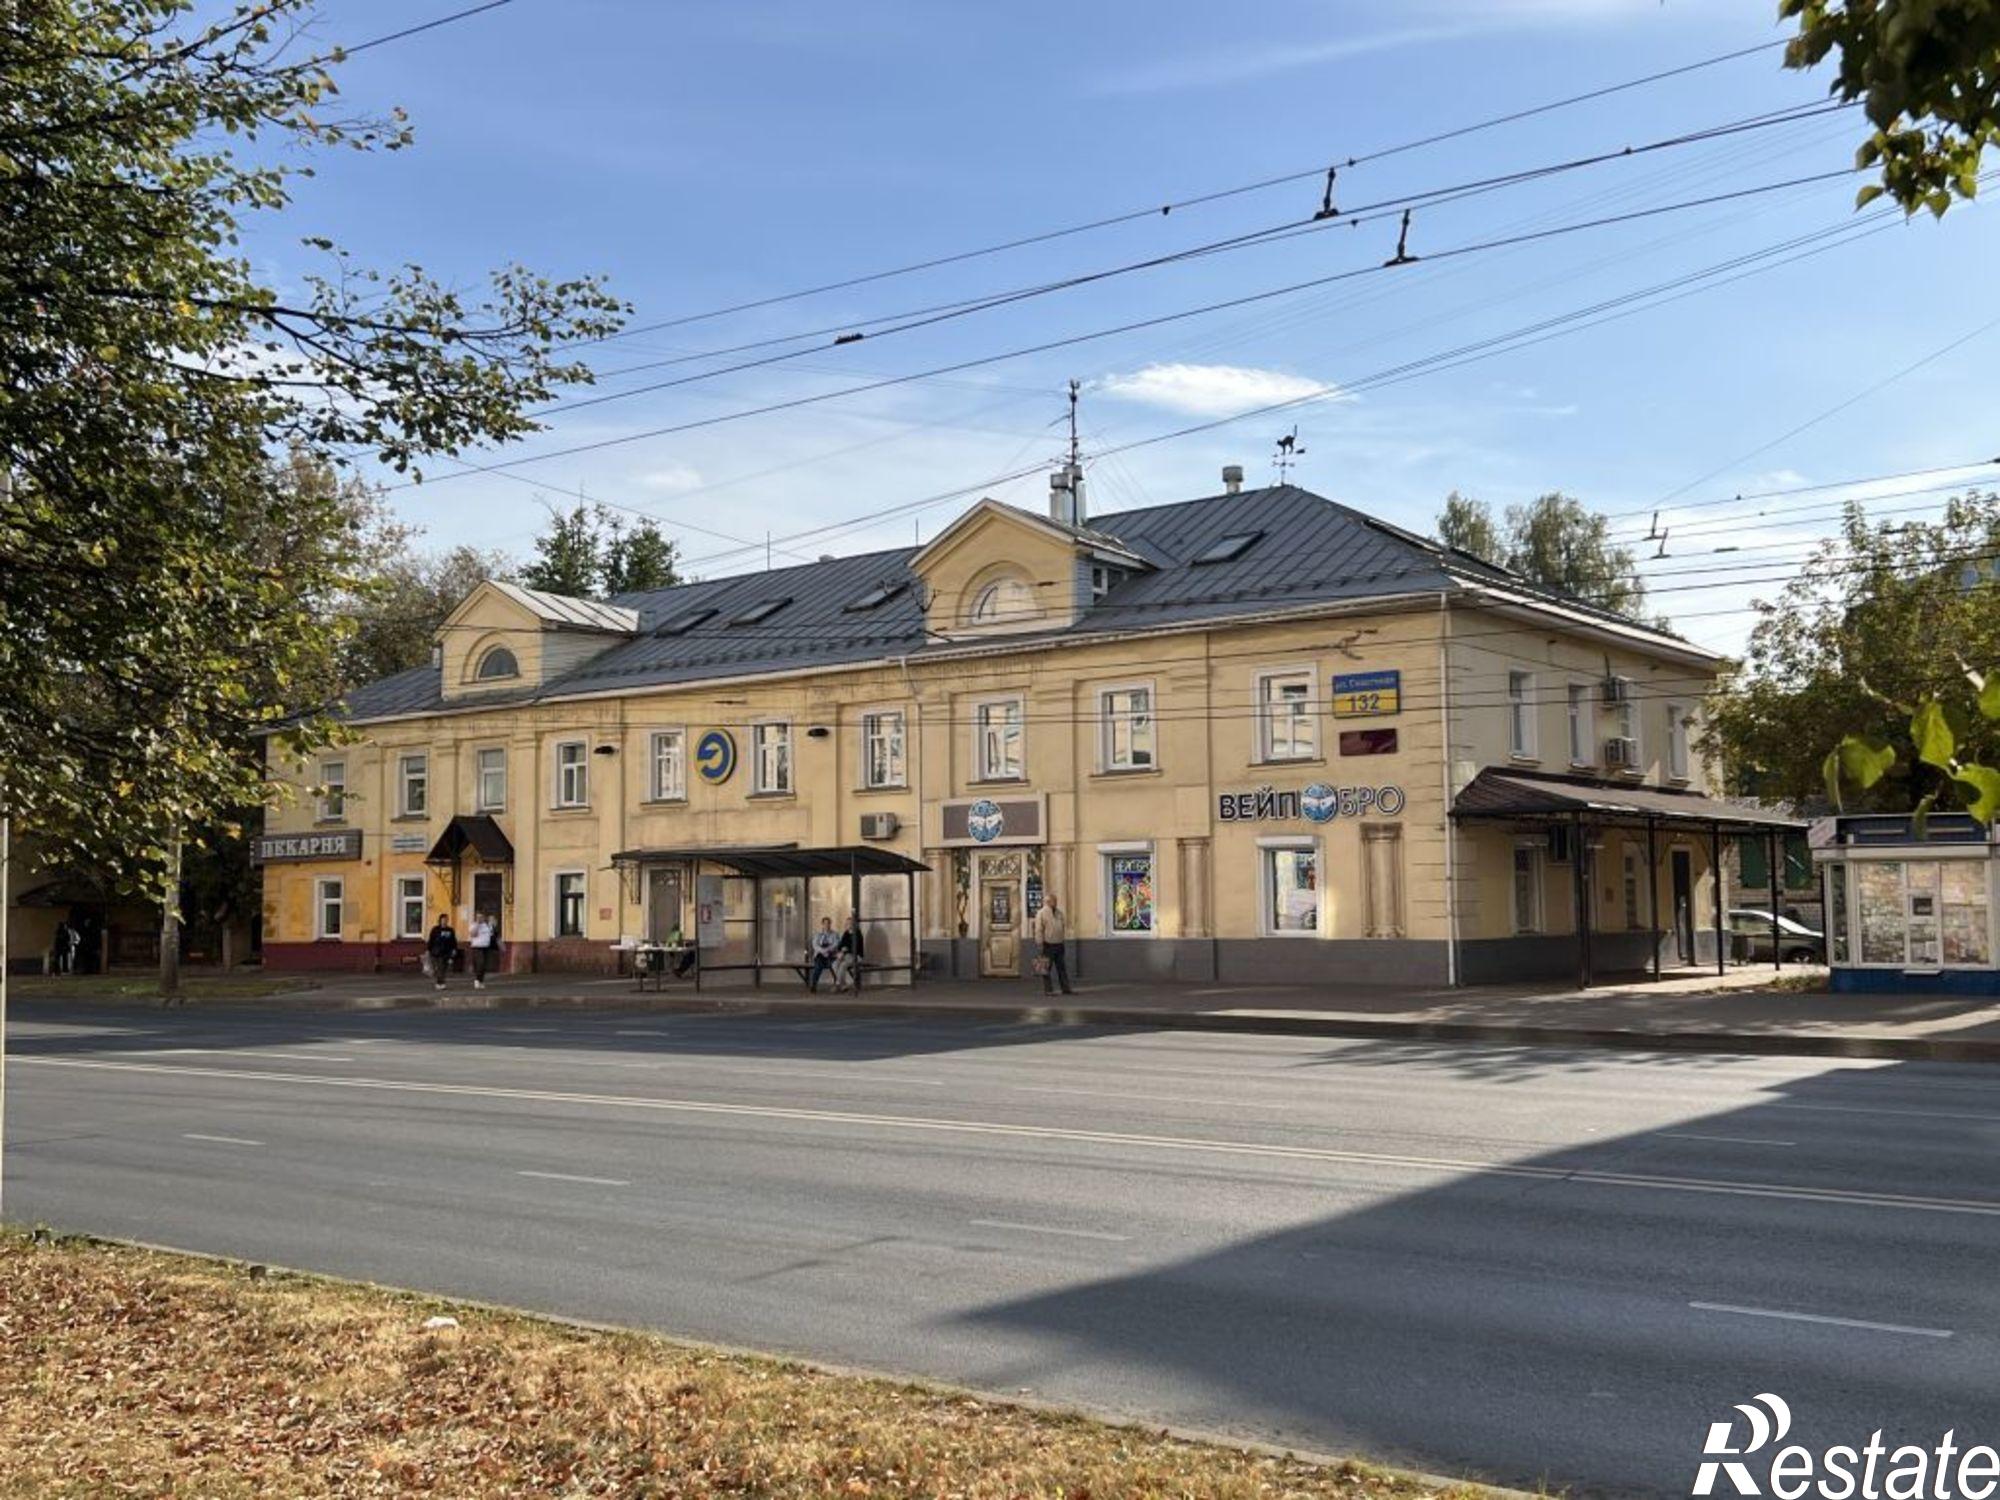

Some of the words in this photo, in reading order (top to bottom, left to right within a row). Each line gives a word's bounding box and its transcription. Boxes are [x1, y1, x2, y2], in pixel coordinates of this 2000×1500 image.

[1350, 693, 1380, 712] 132
[1218, 786, 1299, 821] ВЕЙП
[1339, 785, 1405, 815] БРО
[261, 836, 347, 858] ПЕКАРНЯ
